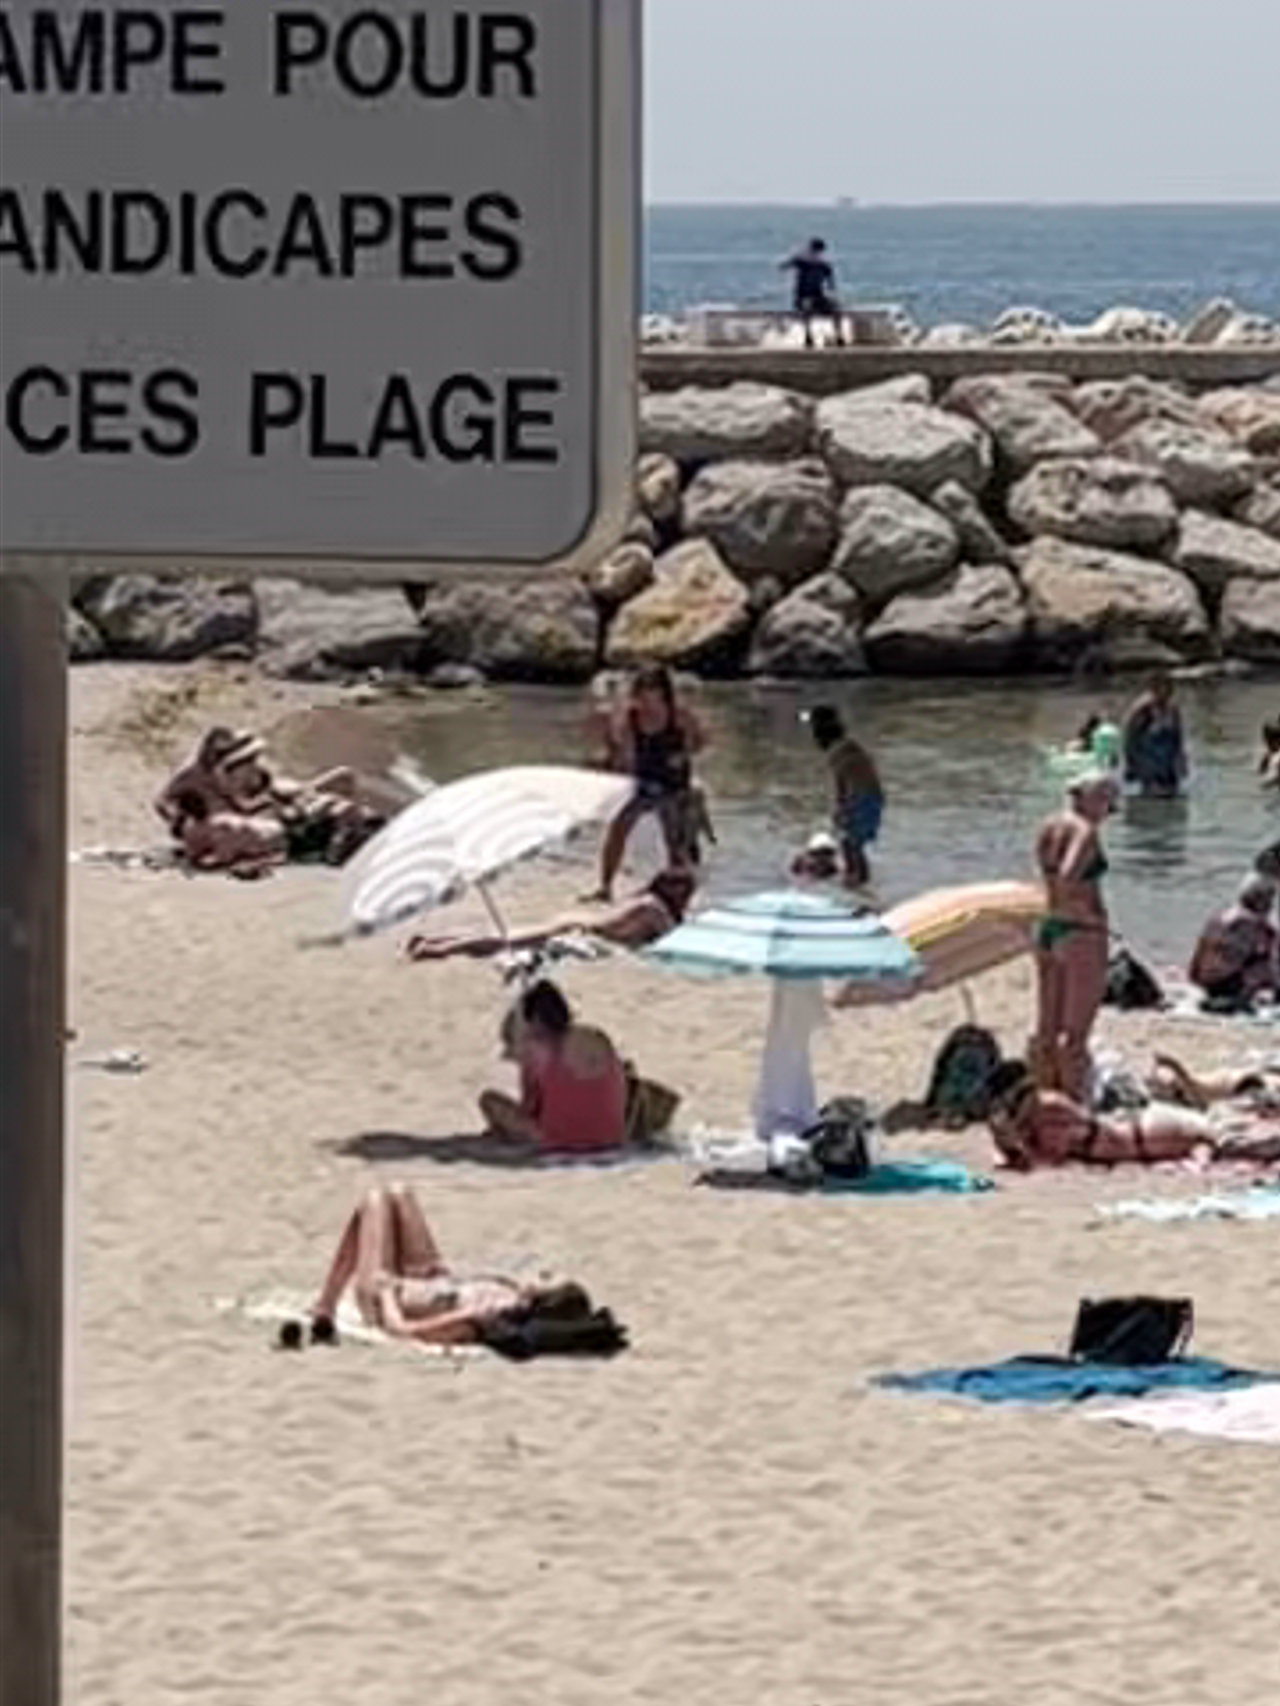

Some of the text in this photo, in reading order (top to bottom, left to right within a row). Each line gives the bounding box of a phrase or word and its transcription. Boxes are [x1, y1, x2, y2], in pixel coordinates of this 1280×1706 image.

[273, 10, 537, 98] POUR
[0, 189, 523, 280] ANDICAPES
[4, 365, 561, 462] CES PLAGE
